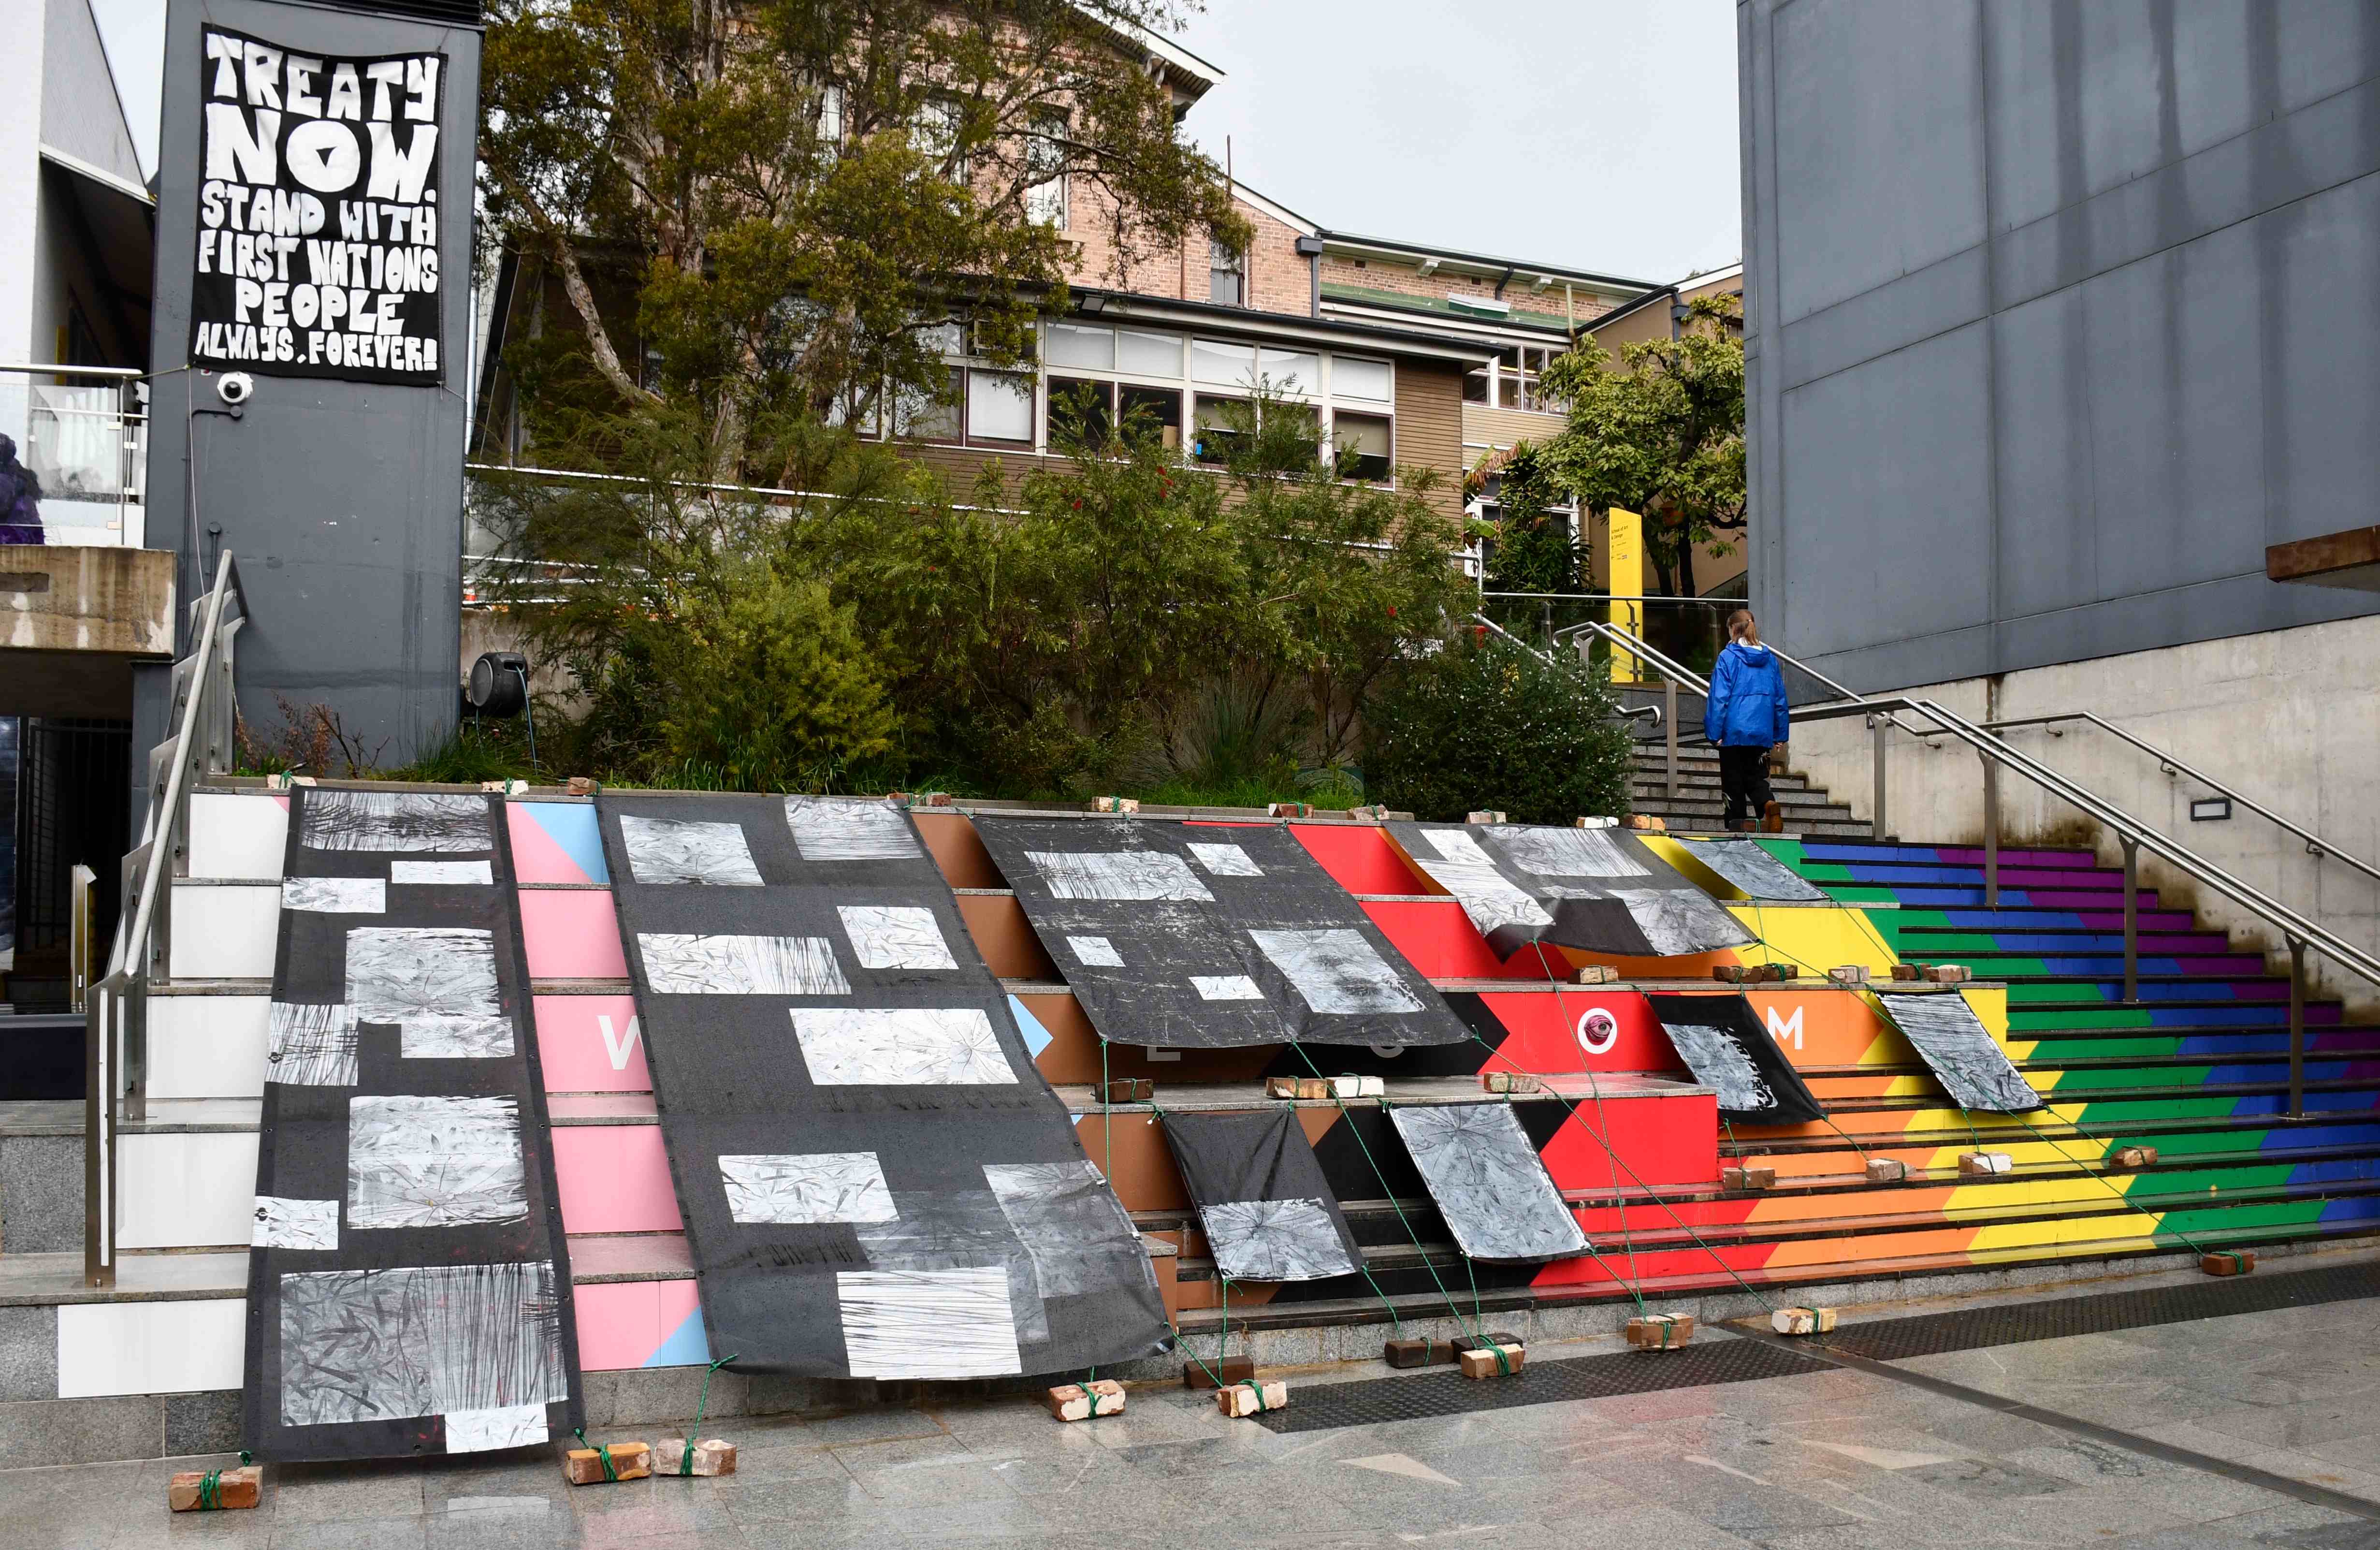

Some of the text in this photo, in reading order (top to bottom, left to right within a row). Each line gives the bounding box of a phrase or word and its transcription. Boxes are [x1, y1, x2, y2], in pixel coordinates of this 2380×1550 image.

[206, 33, 439, 122] TREATY
[205, 102, 439, 204] NOW.
[202, 180, 436, 246] STAND WITH
[198, 230, 438, 293] FIRST NATIONS
[235, 278, 405, 336] PEOPLE
